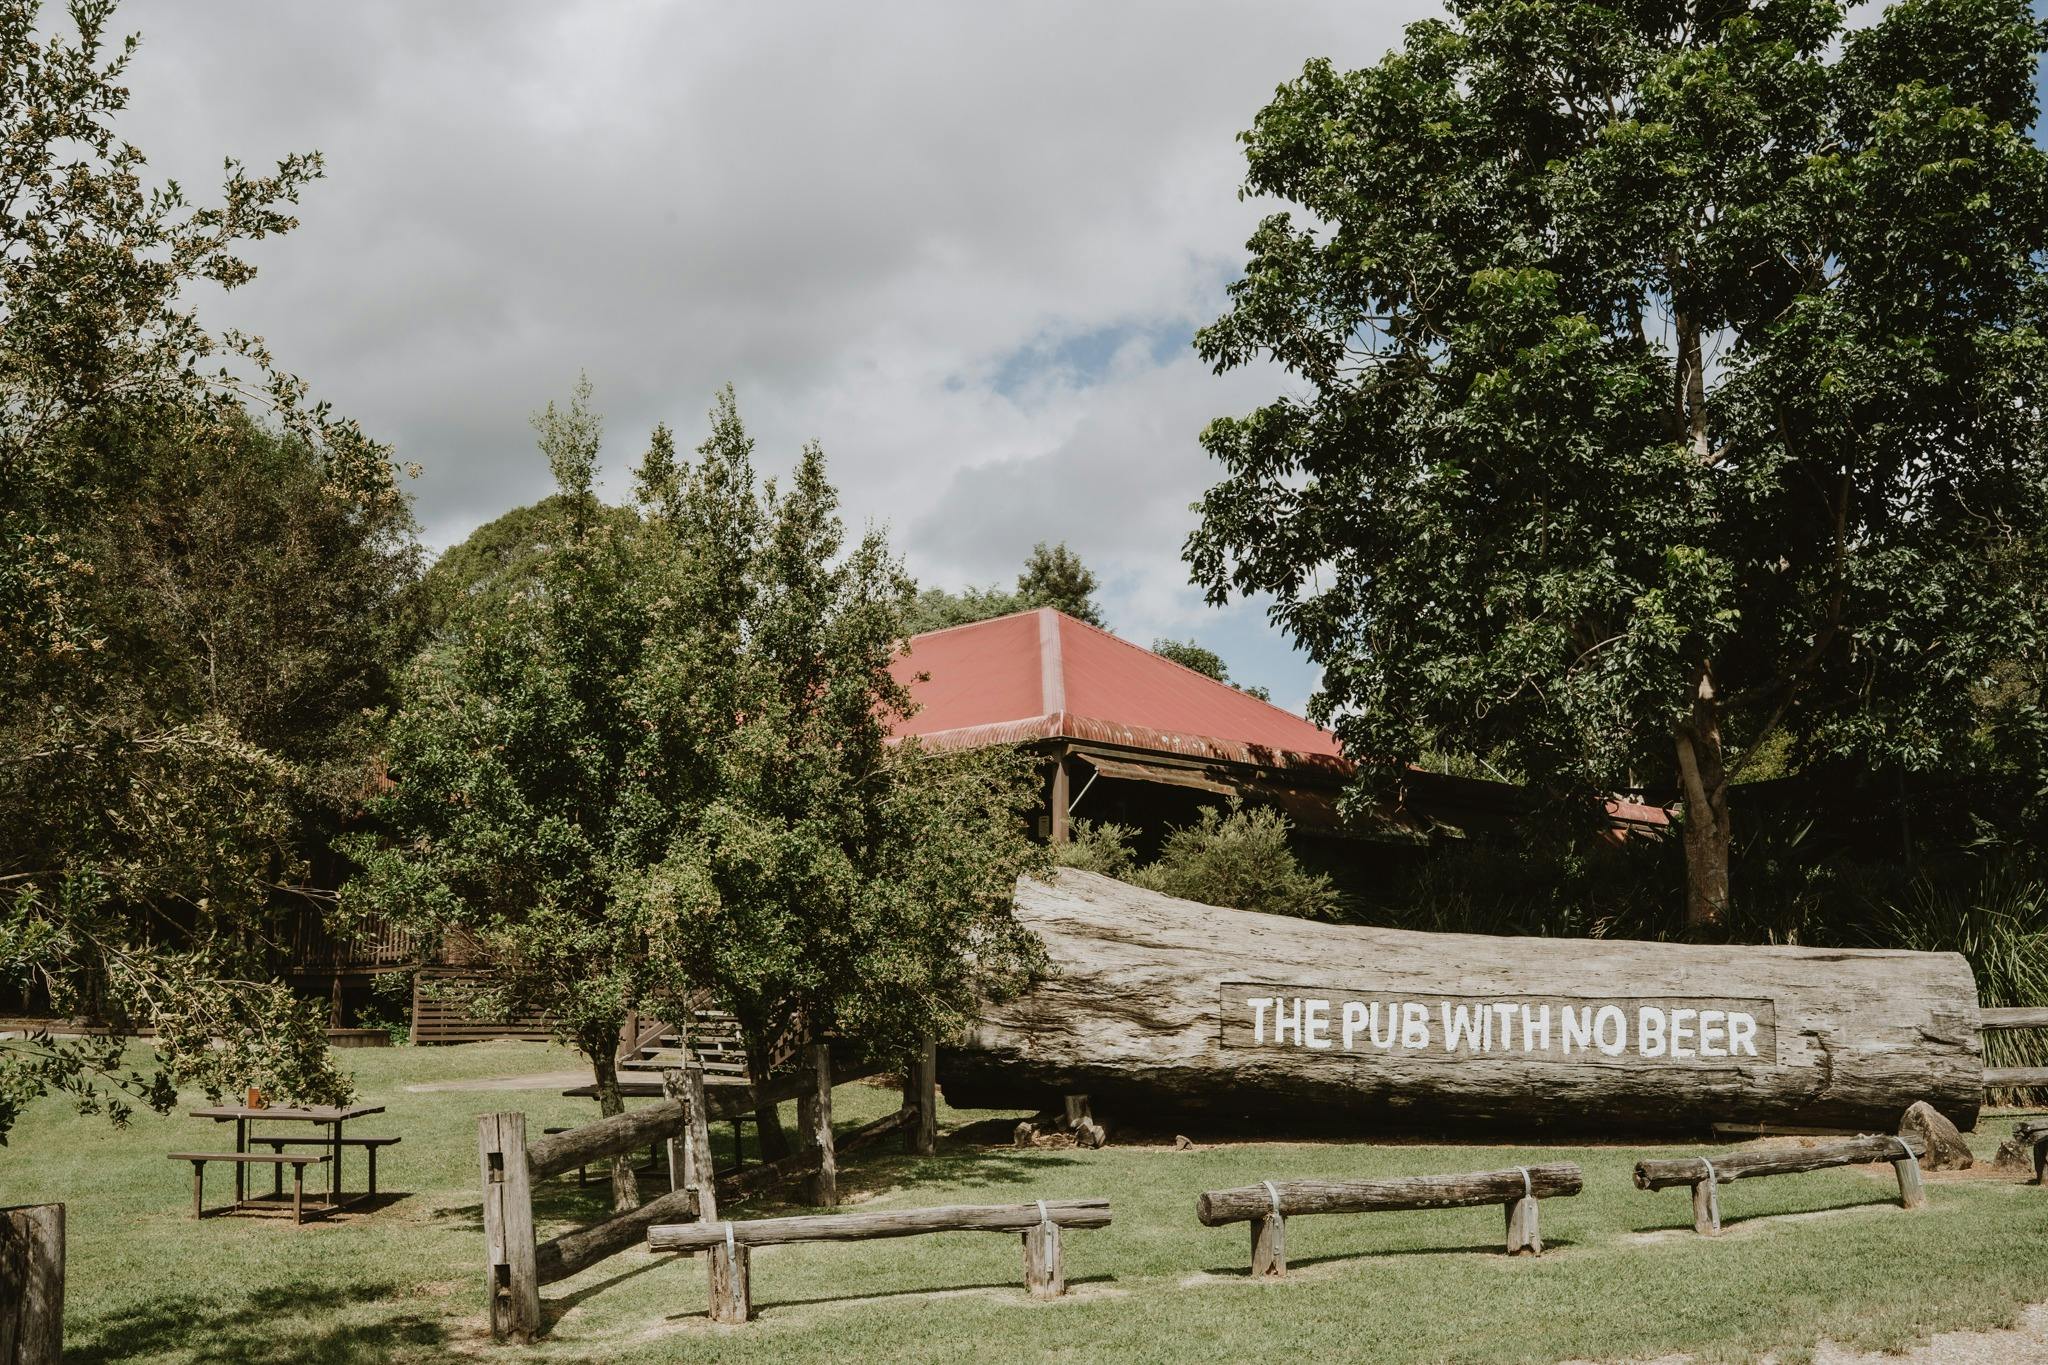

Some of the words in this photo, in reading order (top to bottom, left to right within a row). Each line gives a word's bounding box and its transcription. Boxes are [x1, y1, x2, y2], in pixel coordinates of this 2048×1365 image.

[1247, 998, 1332, 1049] THE
[1343, 1001, 1430, 1050] PUB
[1441, 1001, 1550, 1052] WITH
[1561, 1005, 1627, 1057] NO
[1639, 1006, 1758, 1058] BEER
